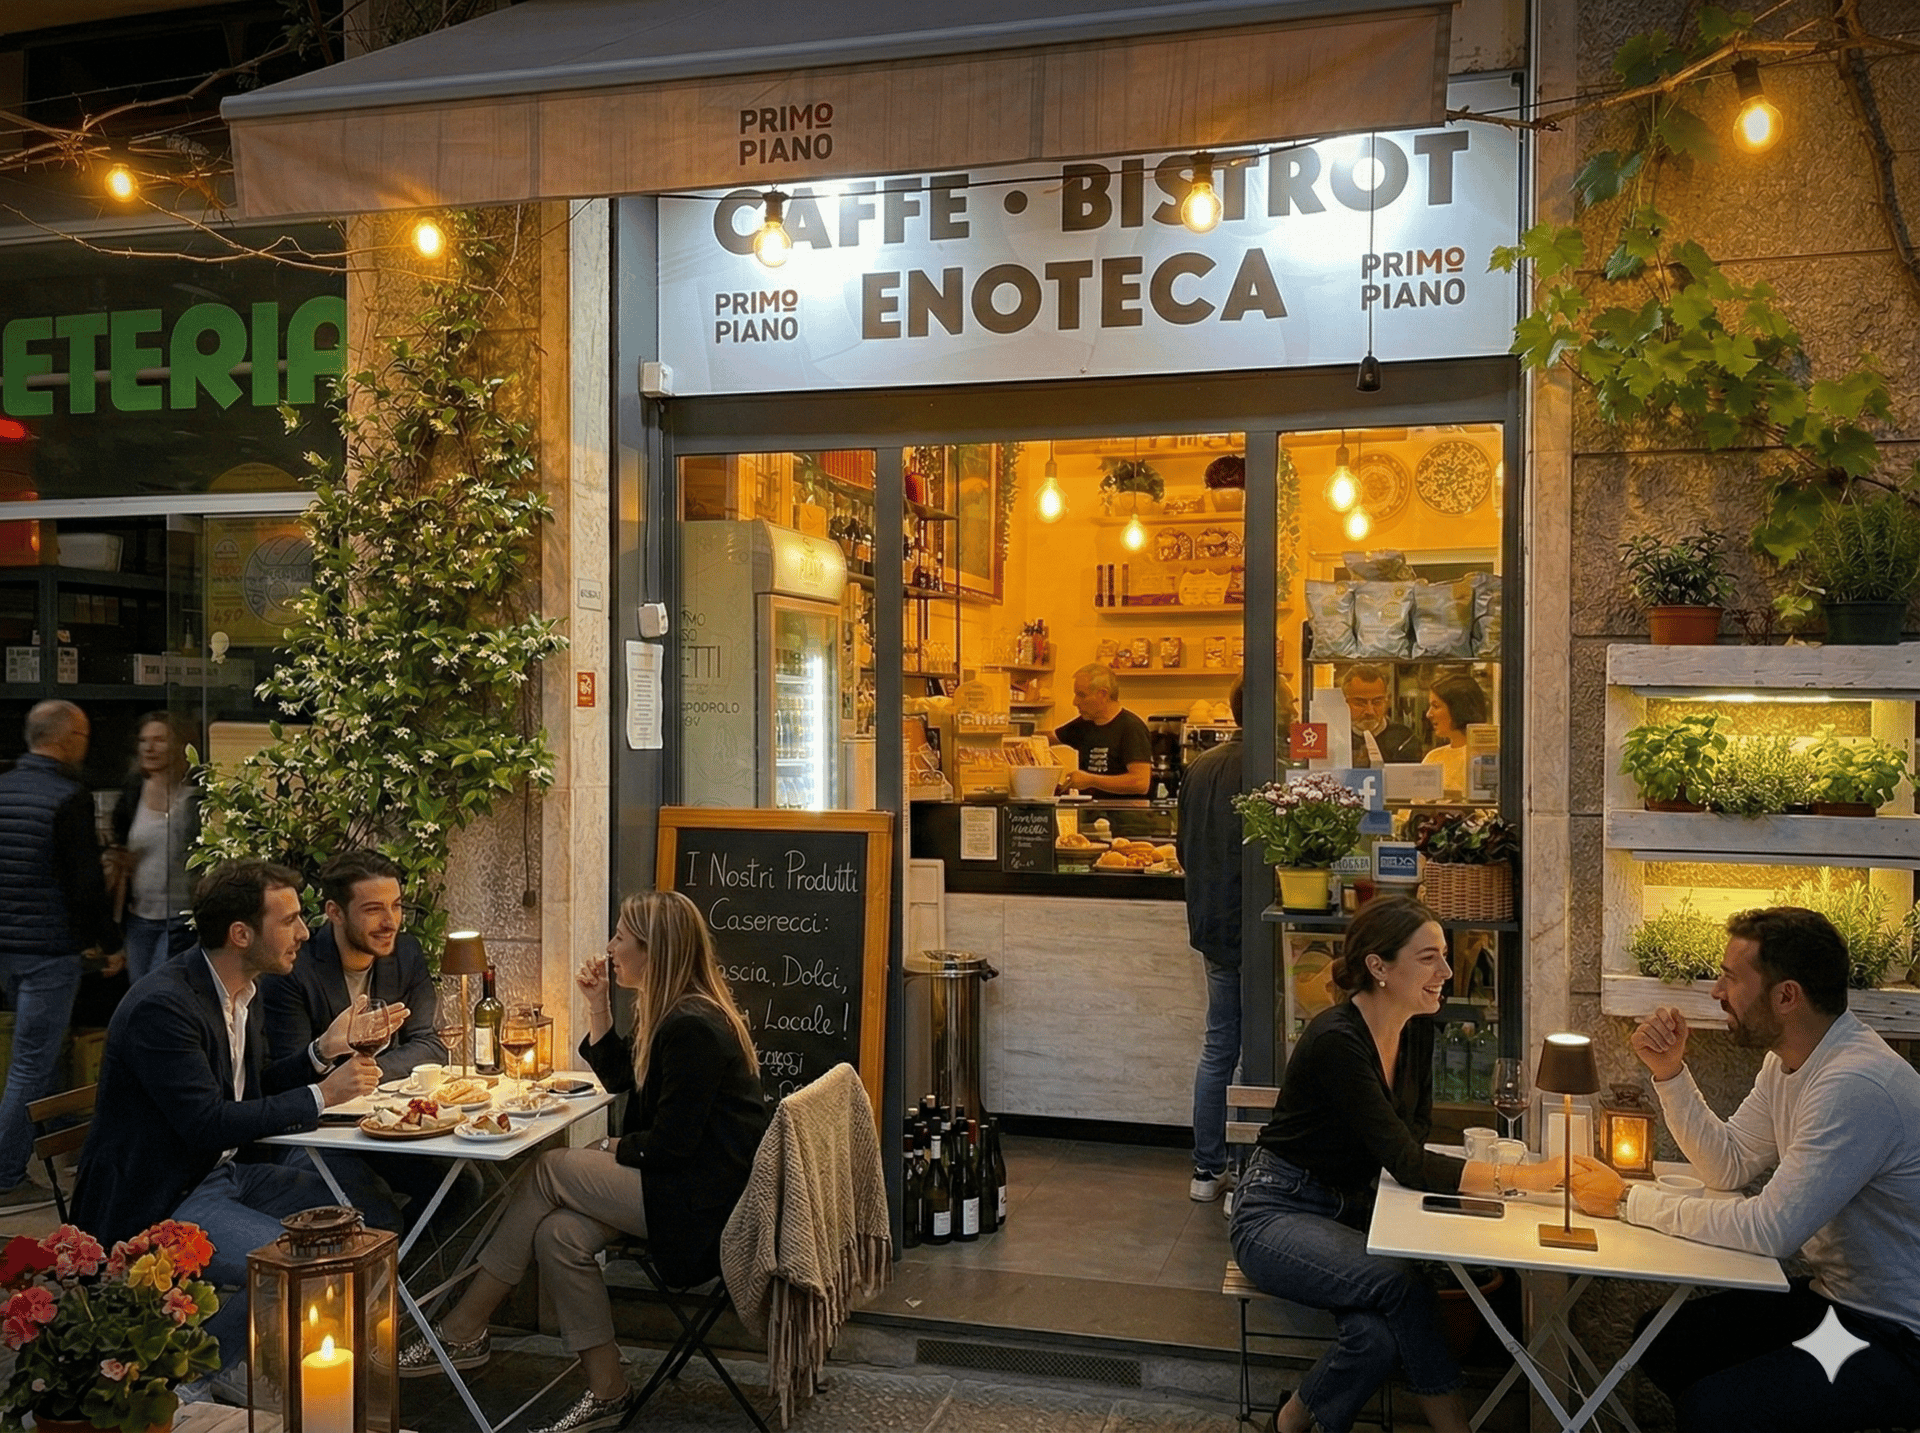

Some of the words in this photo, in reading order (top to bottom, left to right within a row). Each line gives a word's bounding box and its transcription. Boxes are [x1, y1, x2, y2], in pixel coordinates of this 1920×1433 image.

[739, 101, 834, 135] PRIMO
[739, 132, 833, 166] PIANO
[713, 173, 970, 256] CAFFE
[1062, 129, 1470, 233] BISTROT
[1360, 246, 1466, 280] PRIMO
[714, 289, 799, 316] PRIMO
[862, 247, 1288, 340] ENOTECA
[1360, 276, 1467, 312] PIANO
[714, 317, 799, 344] PIANO
[3, 295, 347, 416] ETERIA
[685, 850, 700, 887] I
[709, 852, 776, 889] Nostri
[784, 849, 859, 893] Produtti
[708, 897, 830, 934] Caserecci:
[715, 960, 777, 988] ascia,
[782, 954, 848, 995] Dolci,
